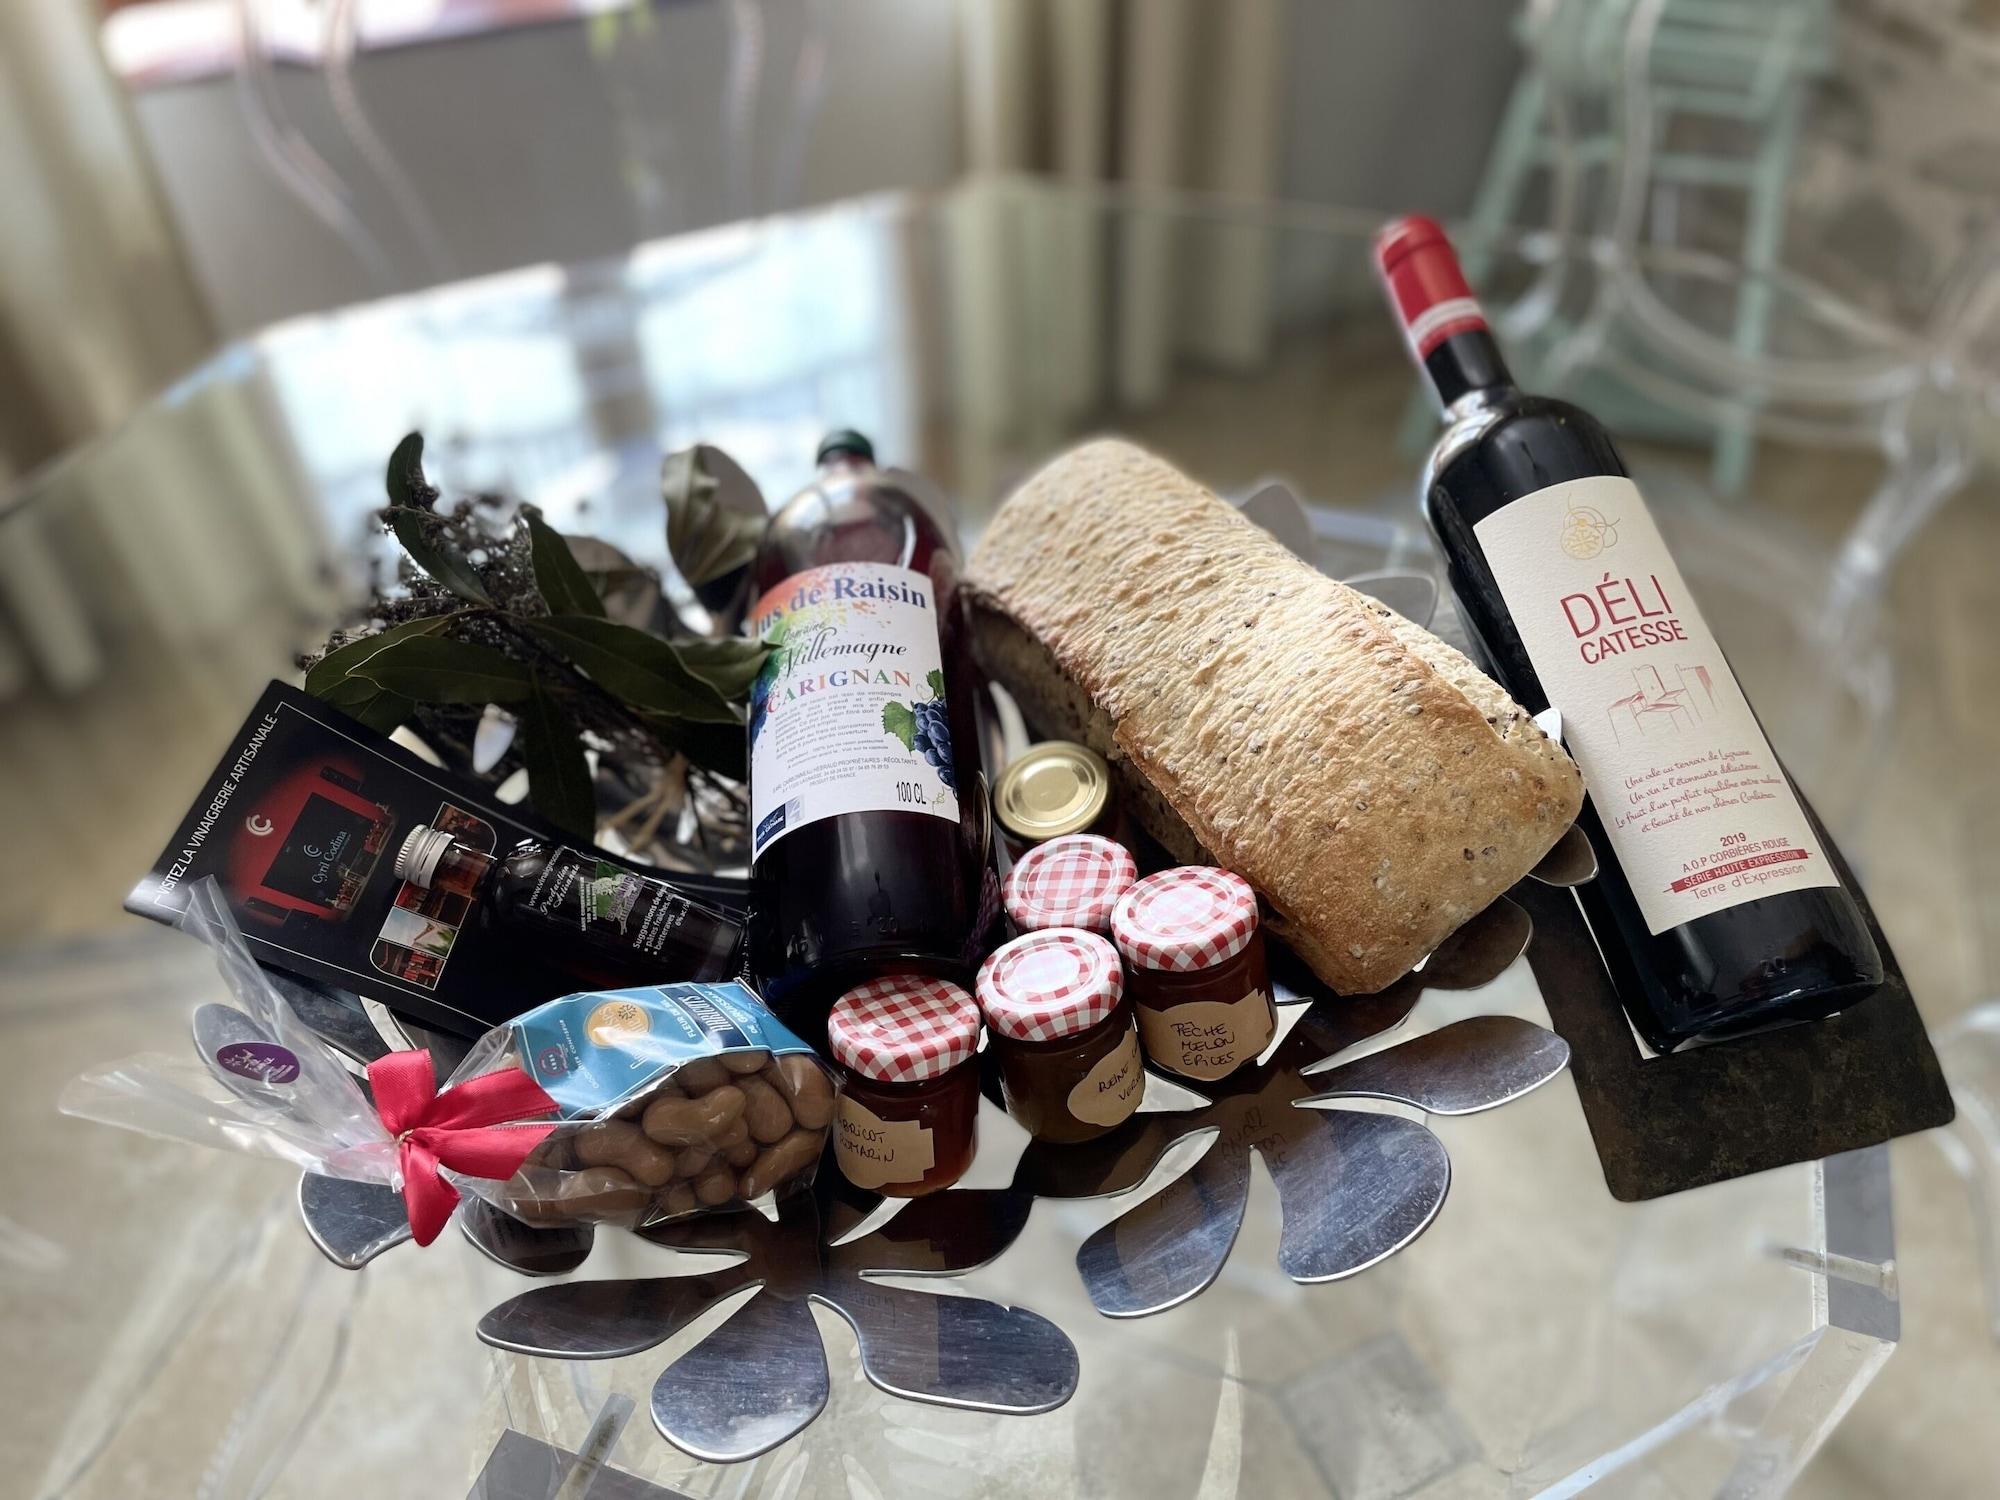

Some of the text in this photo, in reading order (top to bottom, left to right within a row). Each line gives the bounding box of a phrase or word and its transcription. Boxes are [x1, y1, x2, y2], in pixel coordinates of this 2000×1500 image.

[790, 587, 823, 613] de
[834, 577, 928, 610] Raisin
[1560, 571, 1673, 639] DÉLI
[782, 626, 909, 679] Villemagne
[1580, 619, 1688, 665] CATESSE
[765, 669, 912, 713] CARIGNAN
[1624, 776, 1643, 790] Une
[1645, 767, 1661, 780] ode
[1663, 766, 1674, 775] au
[1674, 756, 1708, 771] terroir
[1708, 750, 1719, 761] de
[156, 713, 278, 896] VISITEZ LA VINAIGRERIE ARTISANALE
[896, 780, 927, 805] 100 CL
[1615, 816, 1626, 829] Le
[1626, 806, 1647, 825] fruit
[1650, 798, 1668, 813] d'un
[1669, 789, 1702, 810] parfait
[1703, 779, 1740, 797] équilibre
[1629, 793, 1646, 805] Un
[1662, 782, 1670, 792] à
[1641, 823, 1650, 833] et
[1651, 813, 1680, 828] beauté
[1682, 808, 1694, 818] de
[1695, 804, 1711, 815] nos
[1713, 797, 1740, 810] chères
[311, 861, 330, 884] Cyril
[323, 830, 348, 862] Codina
[1682, 836, 1791, 874] A.O.P CORBIÈRES ROUGE
[1719, 832, 1748, 848] 2019
[1690, 862, 1807, 901] Terre d'Expression
[1714, 861, 1748, 879] HAUTE
[1748, 849, 1801, 869] EXPRESSION
[539, 864, 570, 916] Production
[552, 863, 581, 909] Artisanale
[633, 903, 660, 949] Suggestions
[651, 895, 661, 906] de
[644, 924, 660, 948] pâtes
[654, 913, 675, 951] betteraves
[703, 990, 748, 1024] GRUISSAN
[675, 1015, 697, 1039] FLEUR
[1181, 1031, 1235, 1053] MELON
